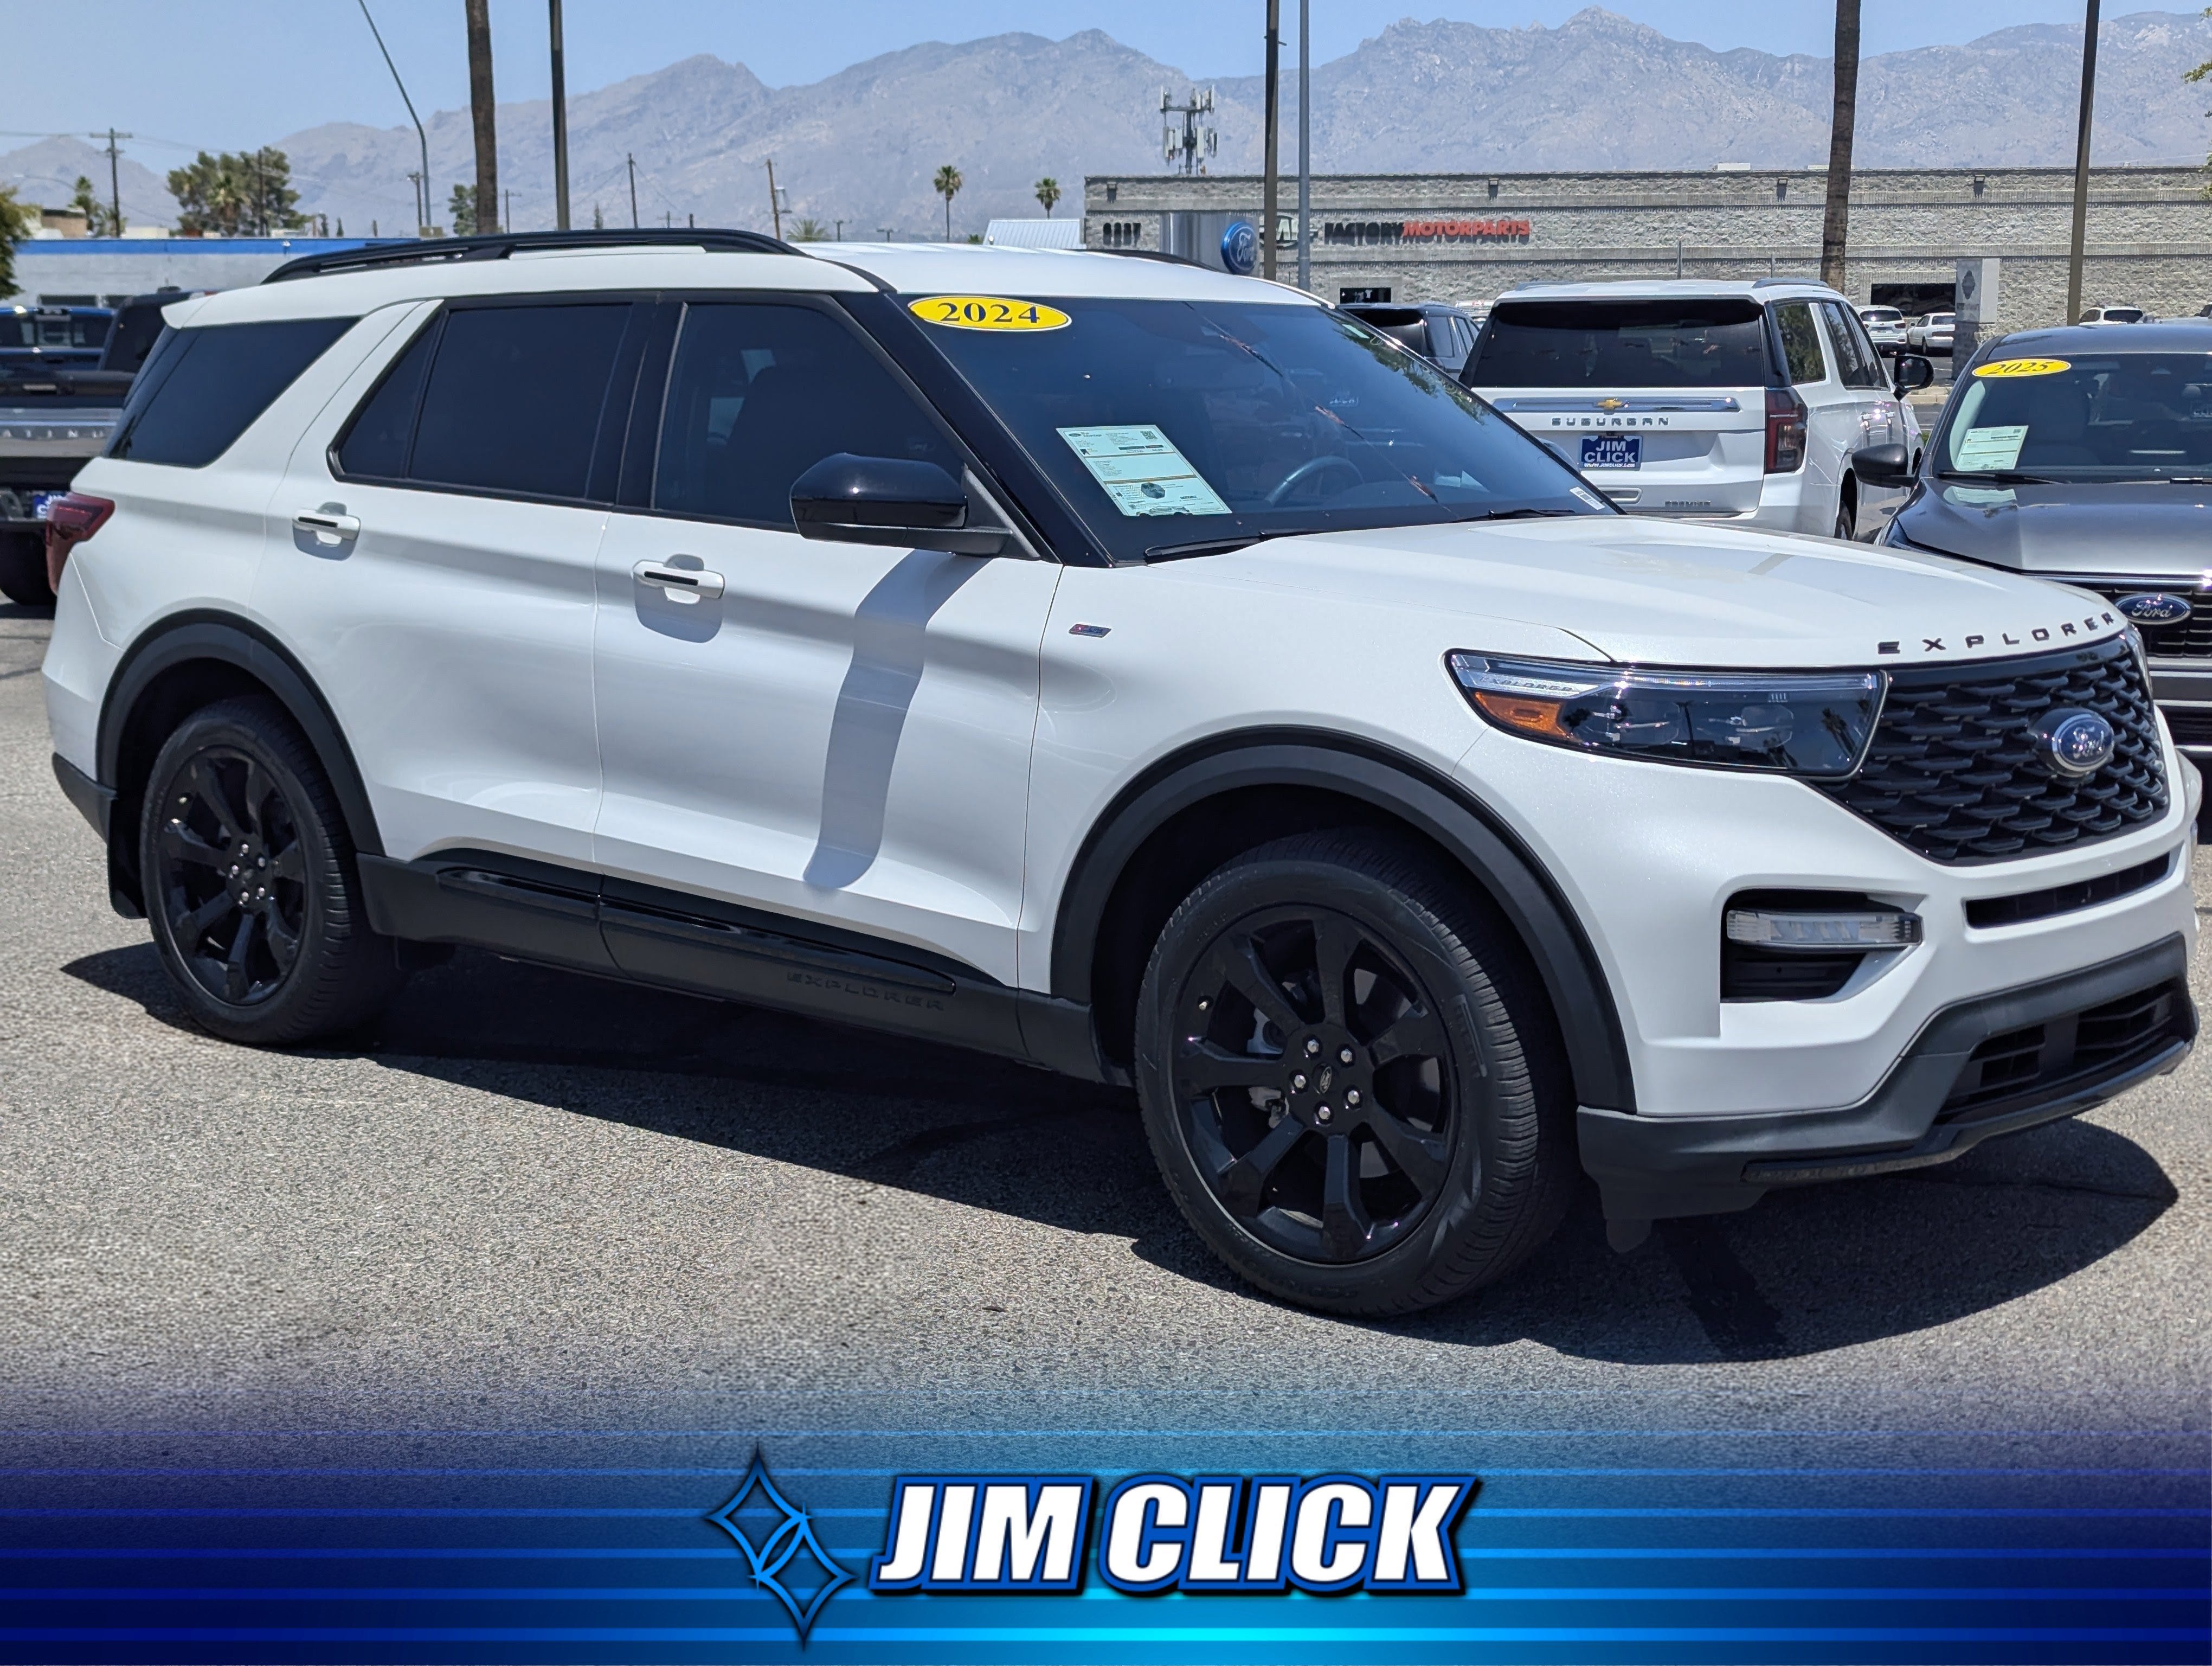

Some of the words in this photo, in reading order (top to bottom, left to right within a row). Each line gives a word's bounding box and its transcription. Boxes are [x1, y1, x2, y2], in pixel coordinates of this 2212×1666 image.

[937, 302, 1040, 324] 2024
[1986, 361, 2054, 375] 2025
[1552, 417, 1669, 426] SUBURBAN
[1596, 440, 1626, 451] JIM
[1584, 452, 1636, 463] CLICK
[2131, 599, 2173, 619] Ford
[1877, 612, 2115, 655] EXPLORER
[1480, 677, 1573, 691] EXPLORER
[2072, 726, 2105, 759] Ford
[786, 971, 944, 1011] EXPLORER
